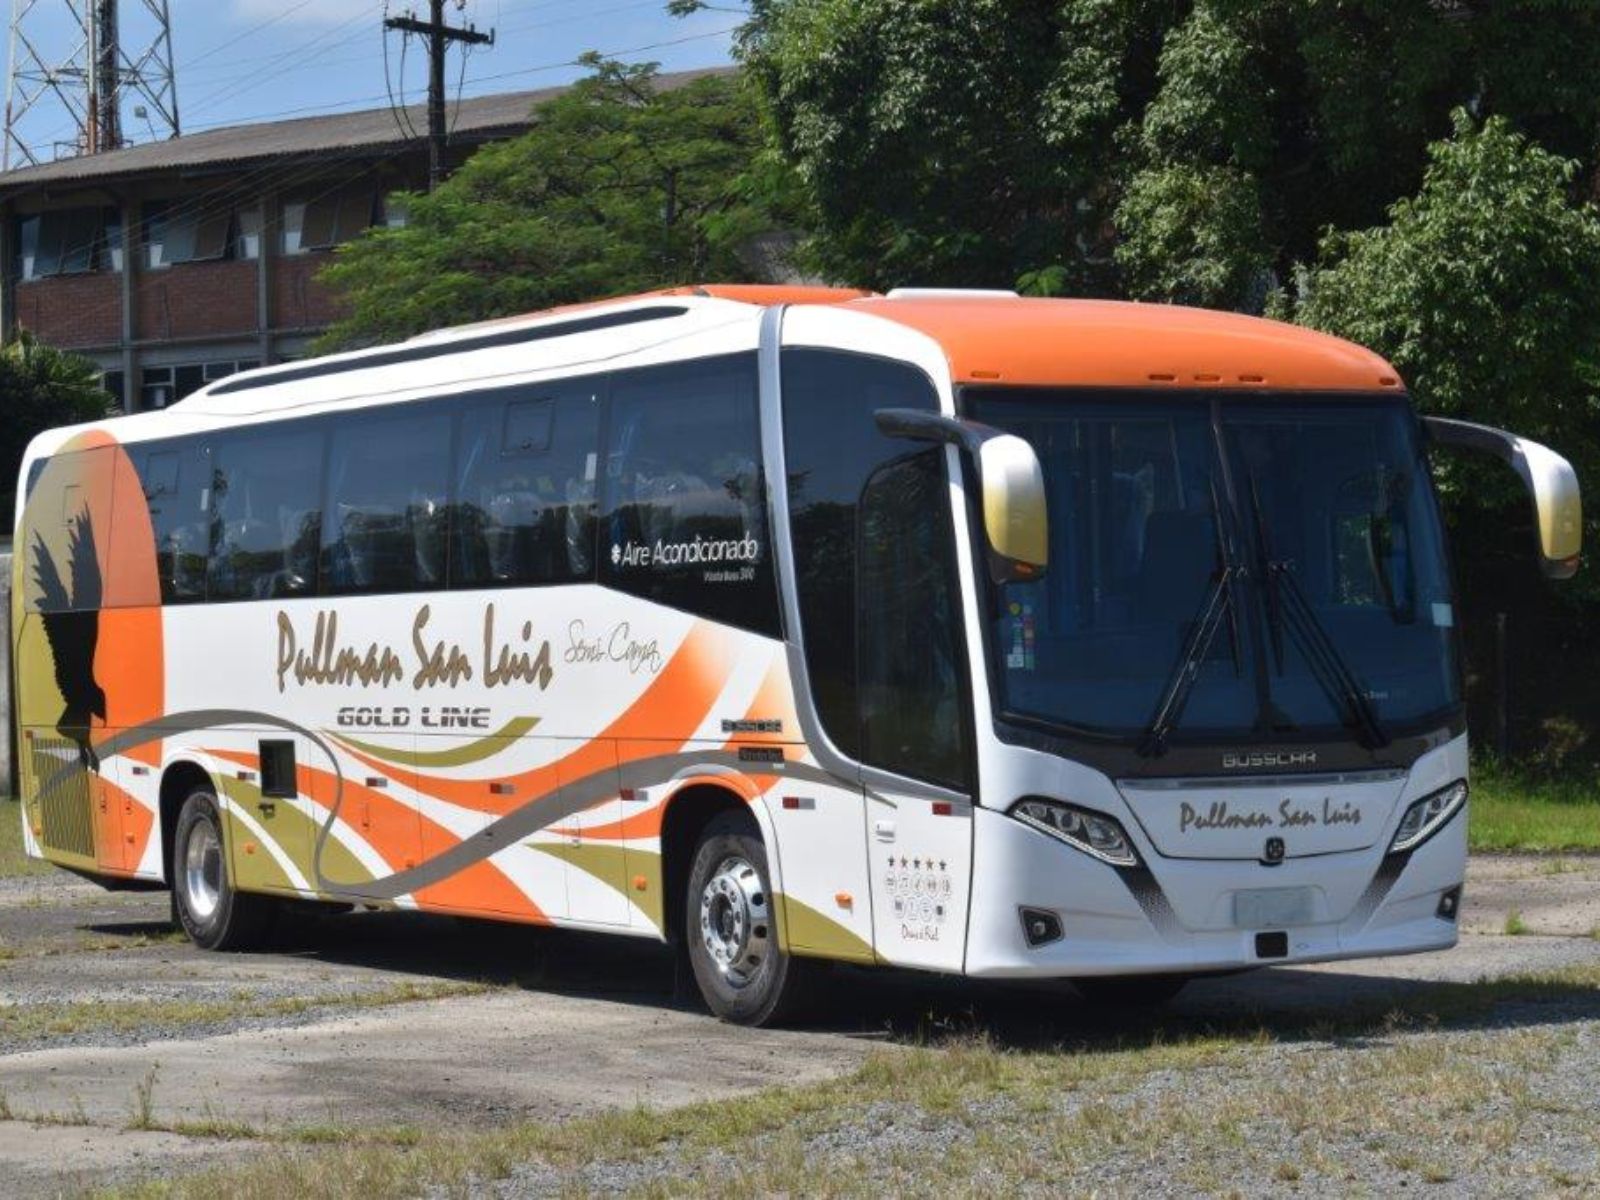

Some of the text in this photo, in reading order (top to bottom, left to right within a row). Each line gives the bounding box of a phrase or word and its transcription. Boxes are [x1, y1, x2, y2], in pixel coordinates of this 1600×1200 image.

[622, 530, 759, 567] Aire Acondicionado
[277, 602, 553, 693] Pullman San Luis
[337, 706, 491, 729] GOLD LINE
[1222, 751, 1317, 769] BUSSCAR
[1180, 797, 1361, 833] Pullman San Luis
